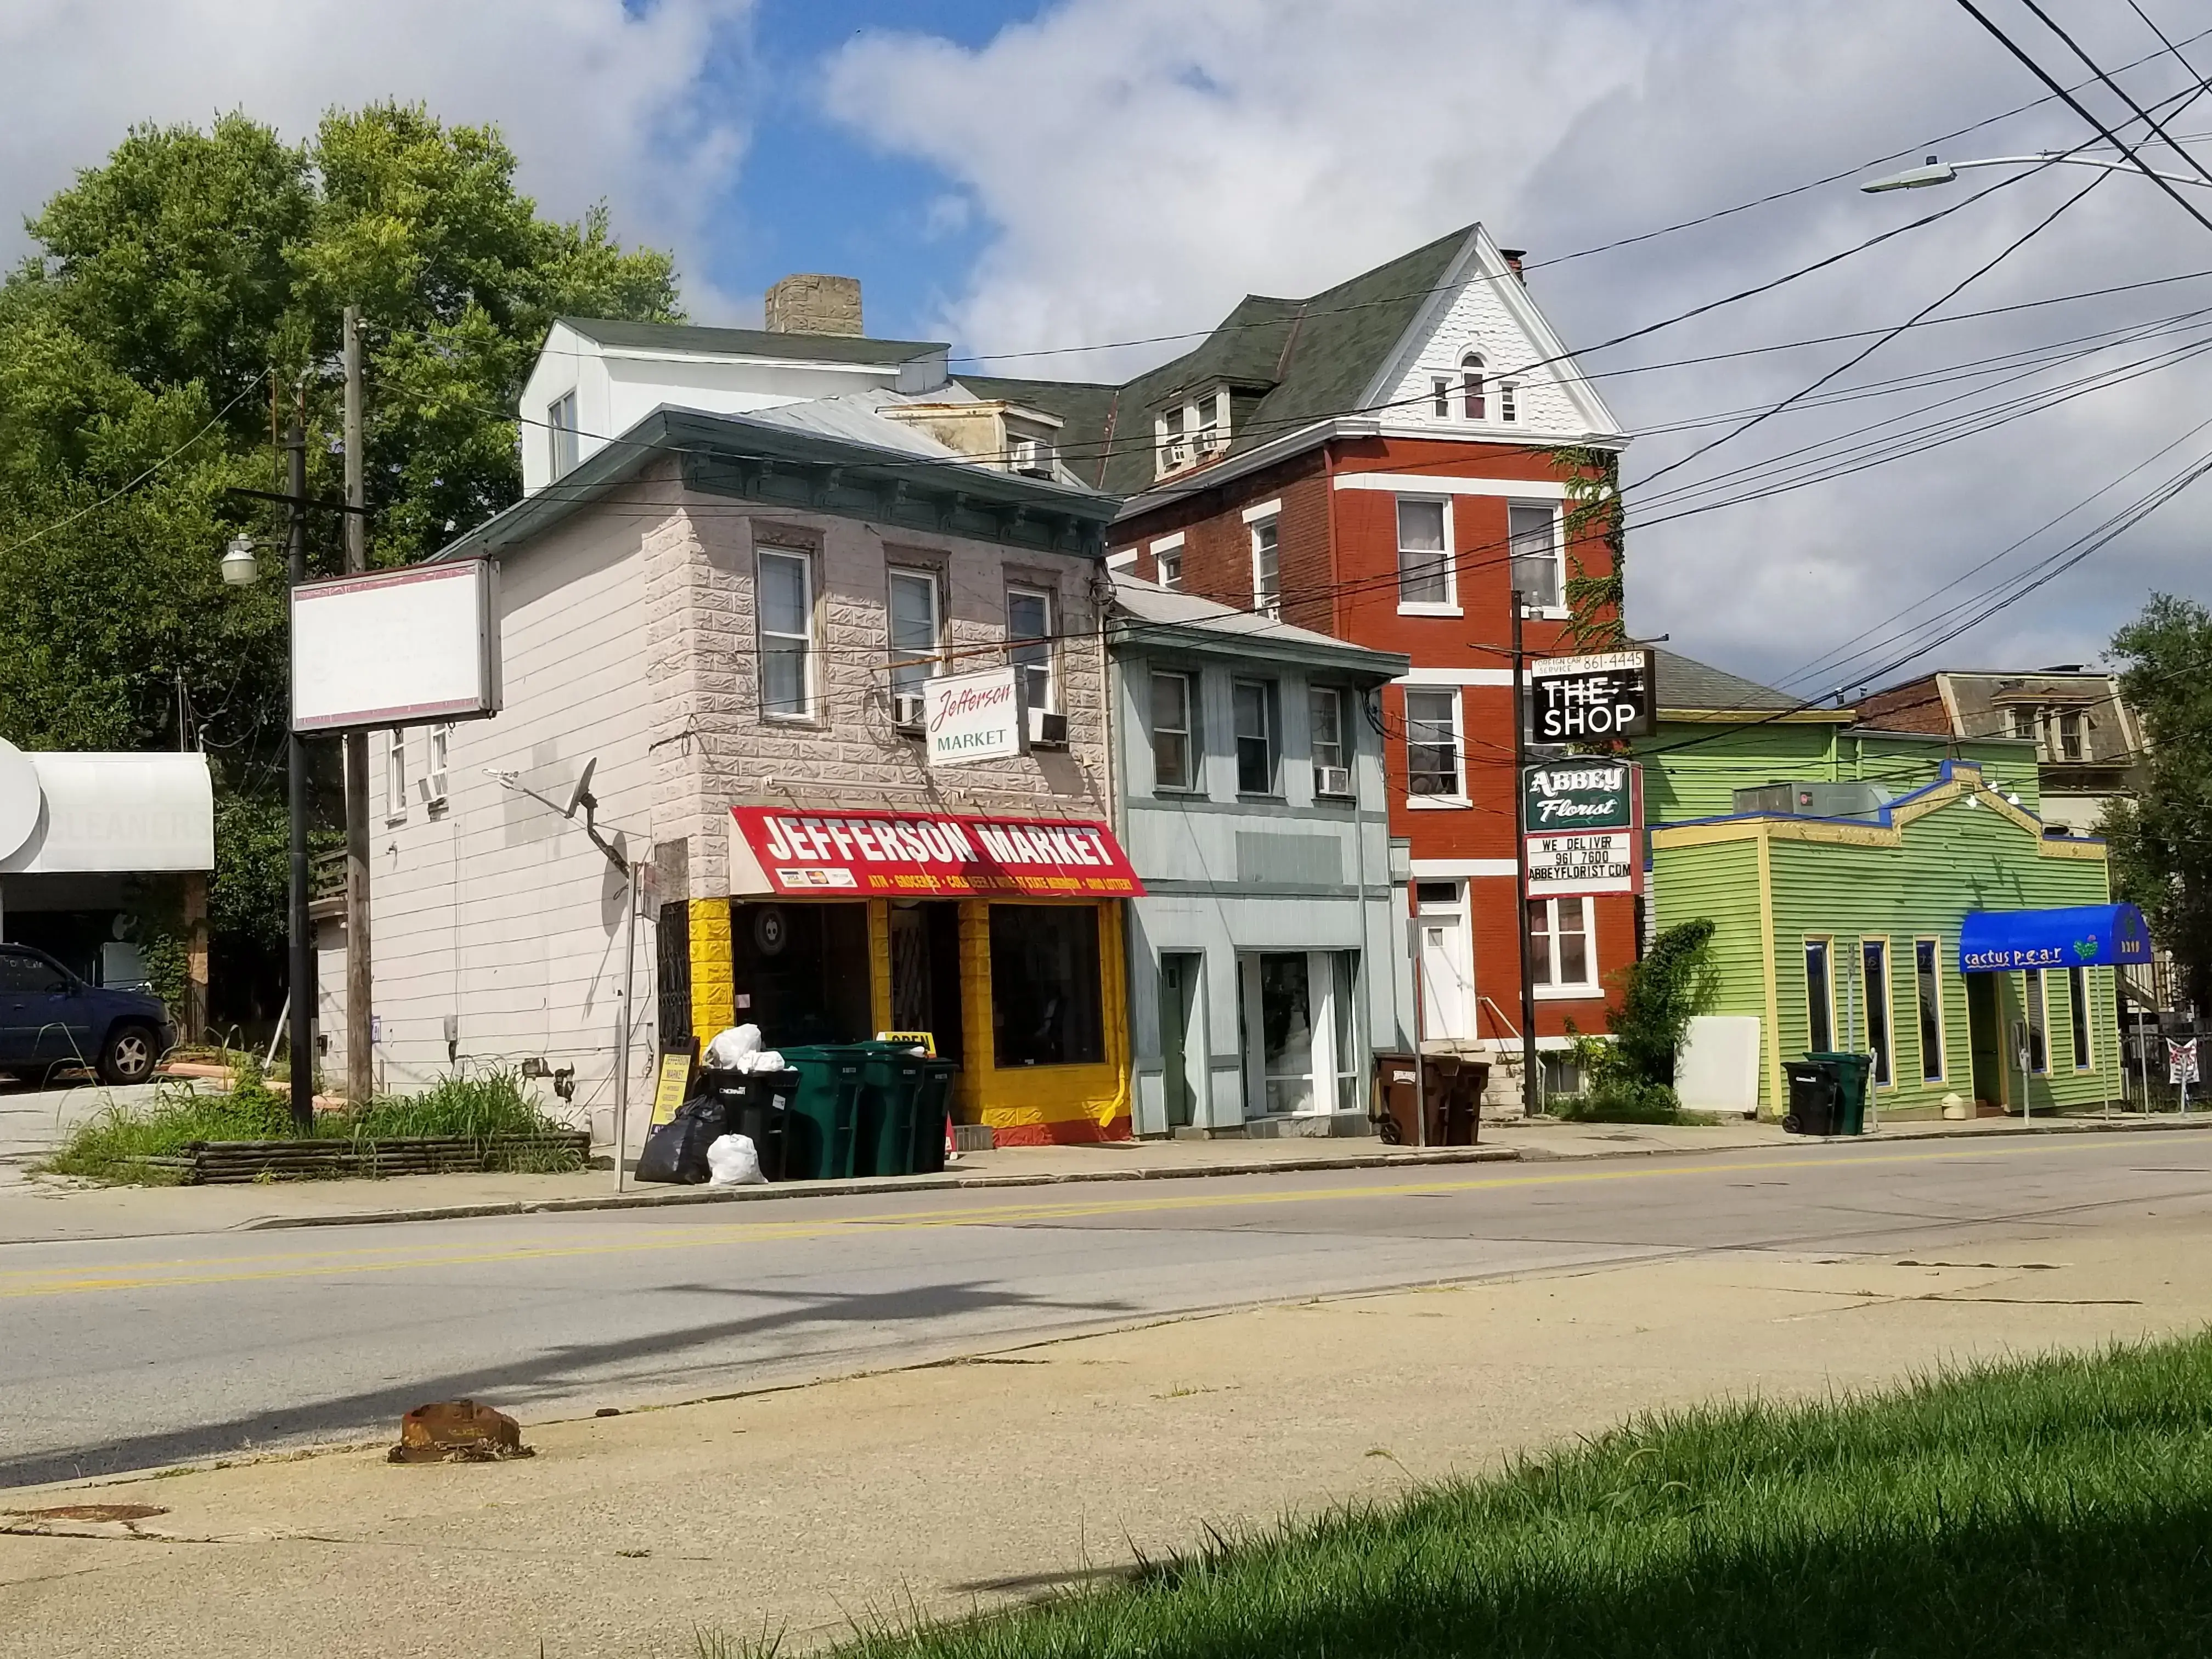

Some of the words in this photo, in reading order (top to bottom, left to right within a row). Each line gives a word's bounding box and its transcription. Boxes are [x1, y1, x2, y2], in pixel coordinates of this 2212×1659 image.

[1539, 665, 1572, 674] SERVICE
[1584, 652, 1642, 669] 861-4445
[1542, 677, 1609, 708] THE
[930, 685, 1011, 732] Jefferson
[1544, 704, 1635, 736] SHOP
[938, 729, 1007, 752] MARKET
[1529, 768, 1624, 798] ABBEY
[1537, 799, 1618, 822] Florist
[763, 816, 978, 863] JEFFERSON
[974, 823, 1114, 865] MARKET
[1543, 839, 1558, 851] WE
[1567, 836, 1612, 850] DELIVER
[1556, 853, 1572, 864] 961
[1582, 851, 1609, 864] 7600
[1529, 865, 1605, 879] ABBEYFLORIST
[1609, 864, 1630, 876] COM
[1965, 950, 2010, 965] cactus
